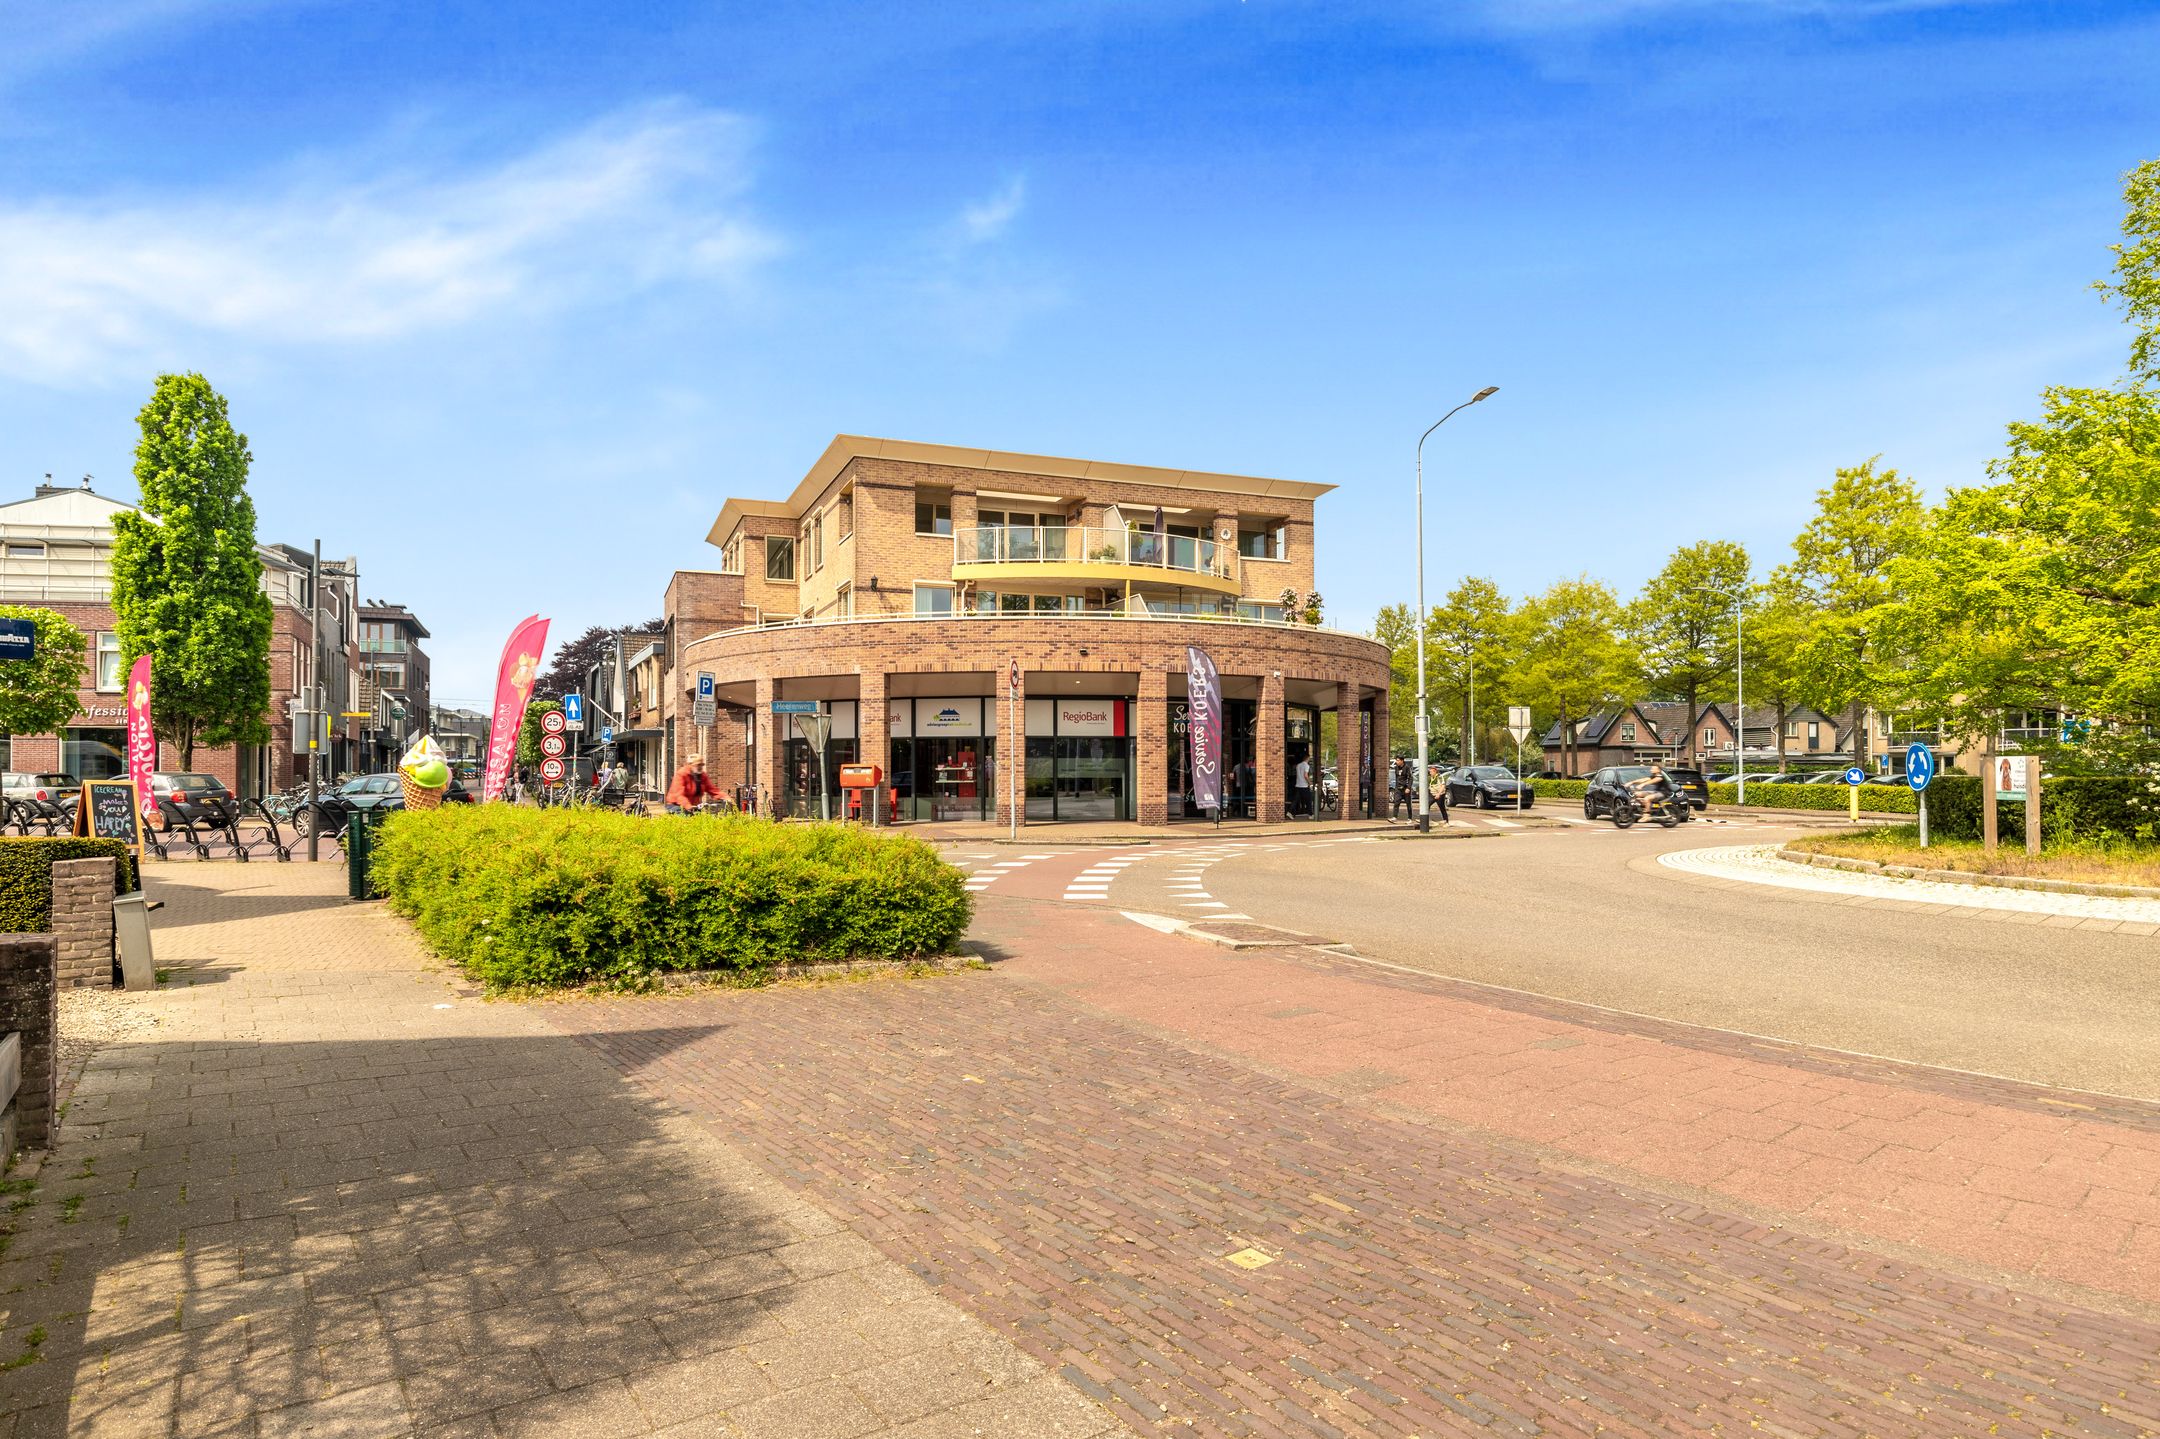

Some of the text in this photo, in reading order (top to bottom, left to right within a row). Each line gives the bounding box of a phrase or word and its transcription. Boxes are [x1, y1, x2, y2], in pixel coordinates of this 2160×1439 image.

[702, 679, 710, 693] P
[546, 718, 561, 727] 25t
[1063, 711, 1107, 723] RegioBank
[604, 729, 610, 737] P
[95, 815, 125, 831] HAPPY
